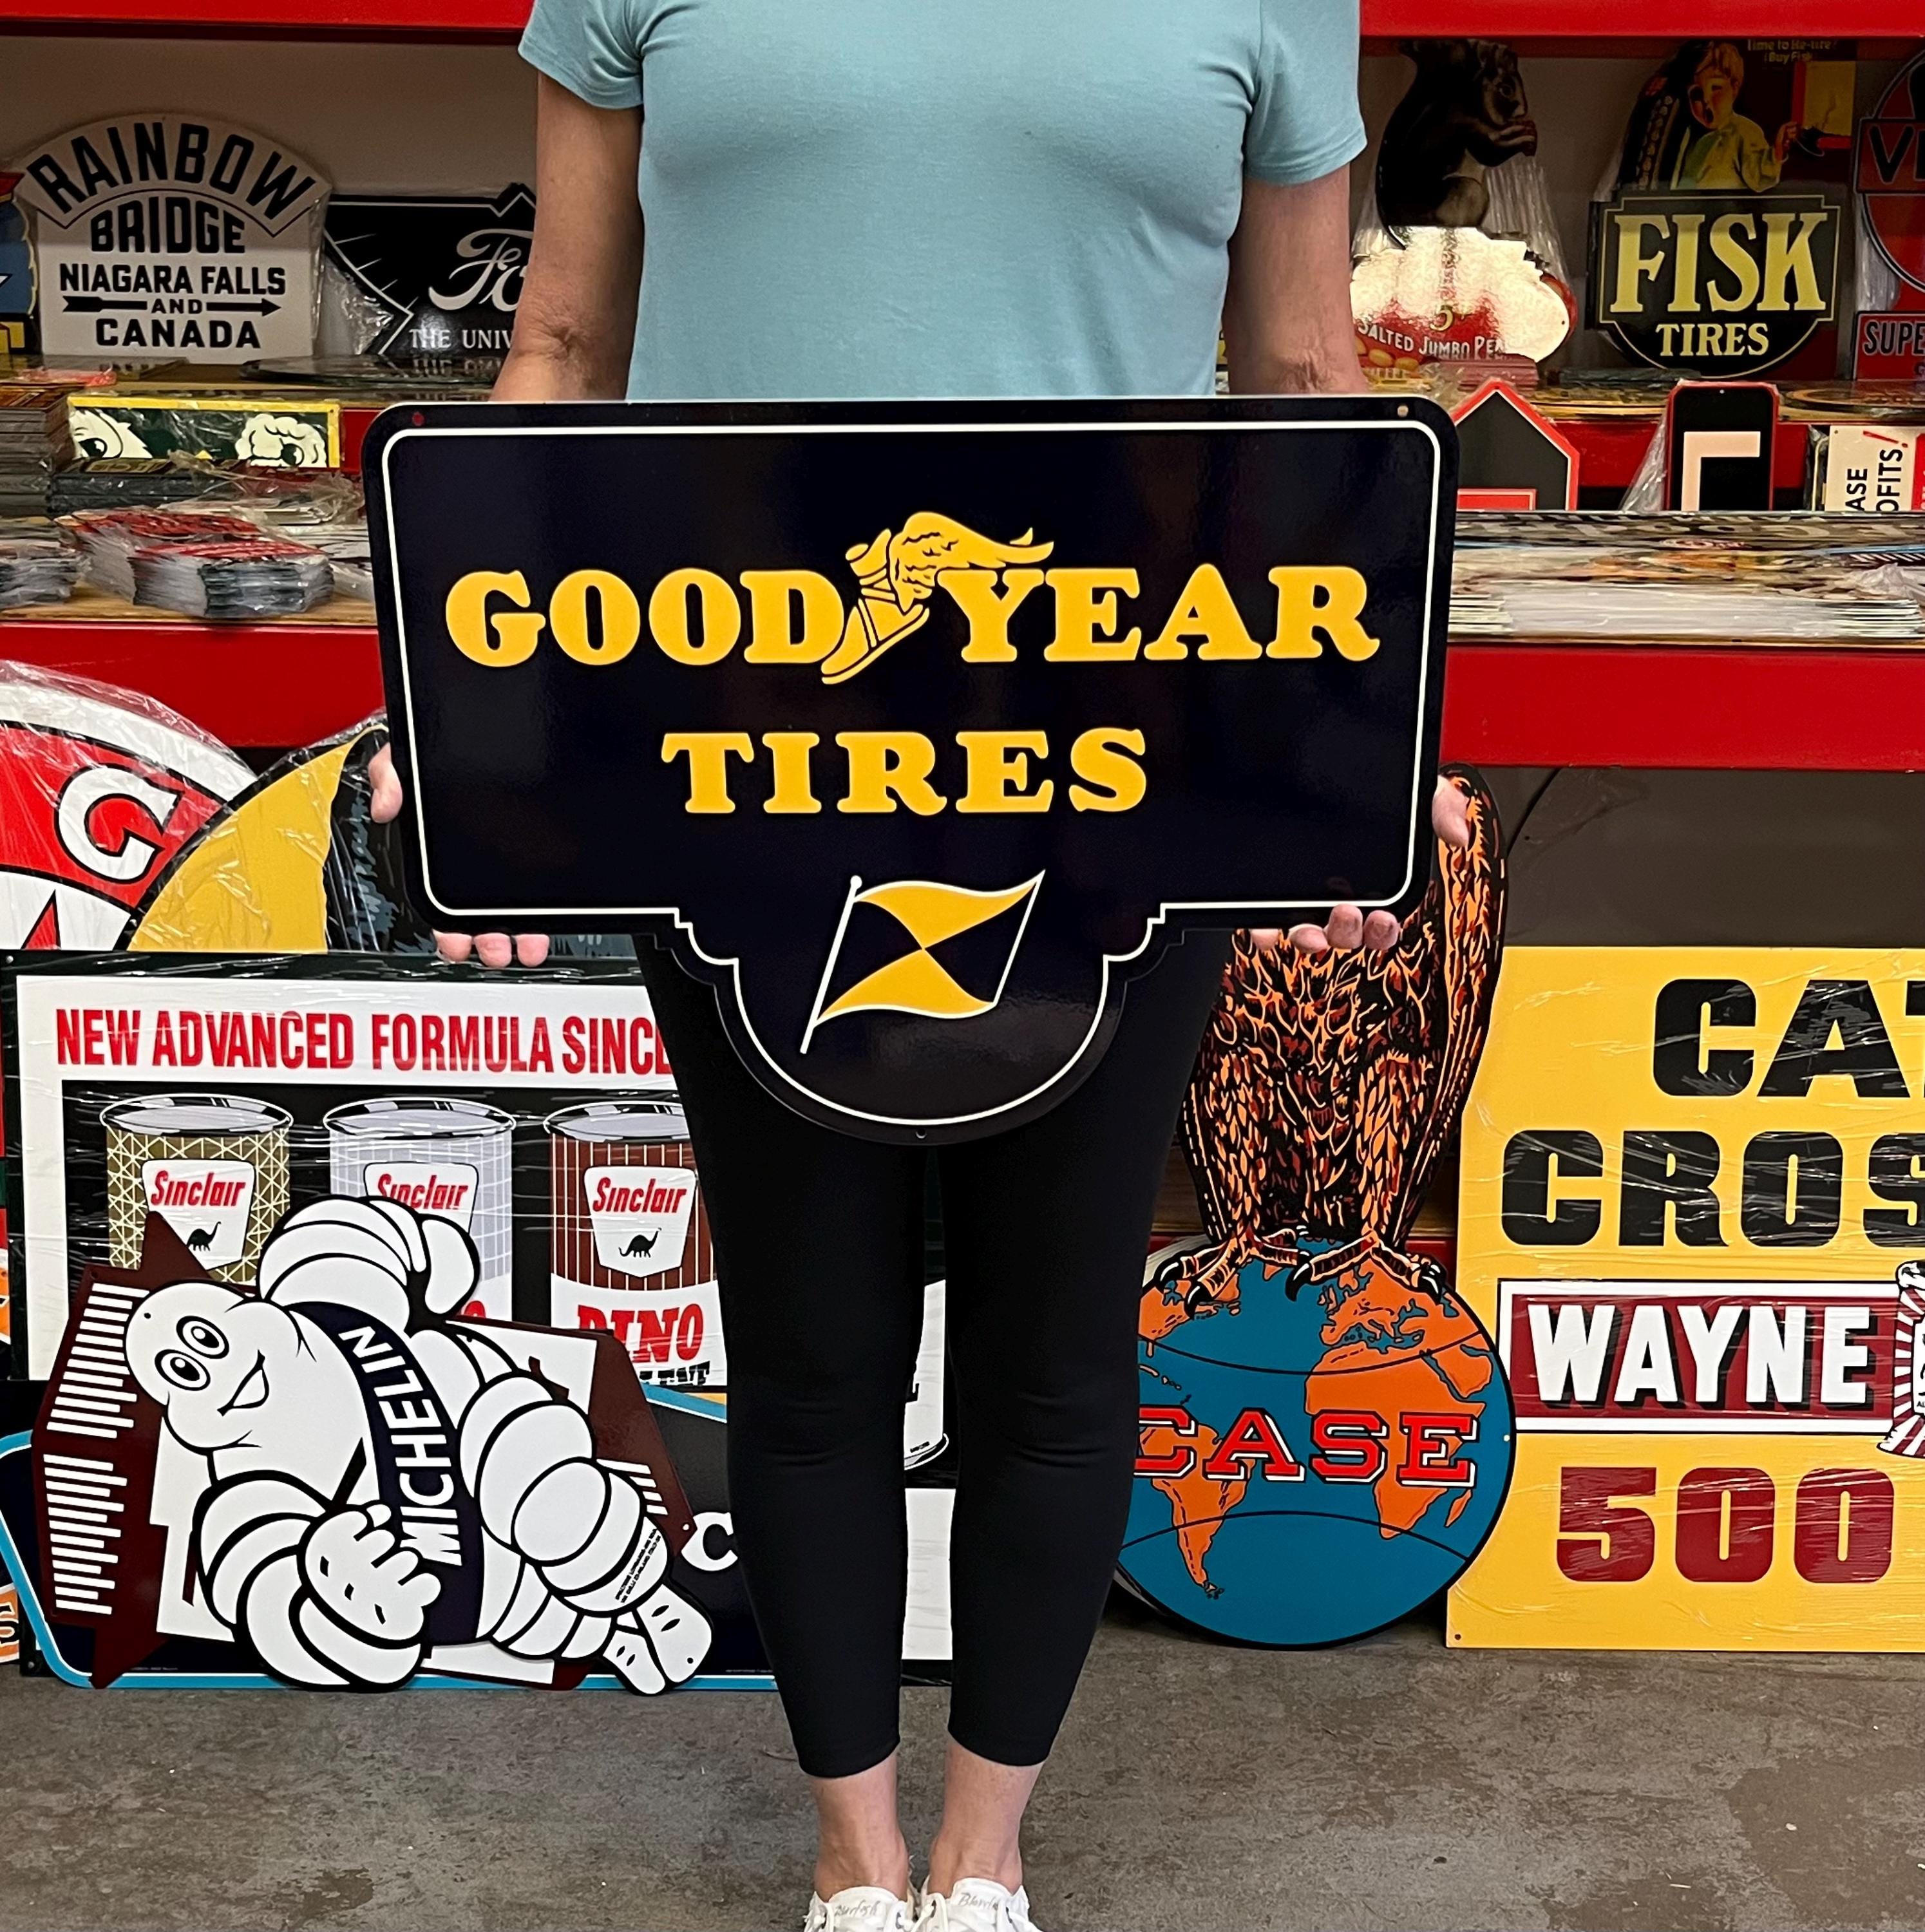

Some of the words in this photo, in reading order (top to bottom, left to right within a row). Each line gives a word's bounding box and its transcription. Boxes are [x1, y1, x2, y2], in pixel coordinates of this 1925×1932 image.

[26, 122, 316, 220] RAINBOW
[91, 196, 245, 253] BRIDGE
[60, 263, 193, 294] NIAGARA
[202, 266, 285, 296] FALLS
[1610, 213, 1828, 312] FISK
[96, 318, 261, 349] CANADA
[151, 299, 202, 314] AND
[1358, 318, 1414, 352] SALTED
[409, 329, 451, 349] THE
[1655, 323, 1769, 356] TIRES
[662, 728, 1146, 816] TIRES
[56, 1009, 140, 1065] NEW
[152, 1010, 354, 1070] ADVANCED
[372, 1013, 554, 1074] FORMULA
[151, 1170, 246, 1208] Sinclair
[593, 1177, 687, 1214] Sinclair
[1527, 1304, 1873, 1407] WAYNE
[338, 1326, 462, 1566] MICHELIN
[1134, 1405, 1479, 1487] CASE
[1557, 1467, 1894, 1584] 500
